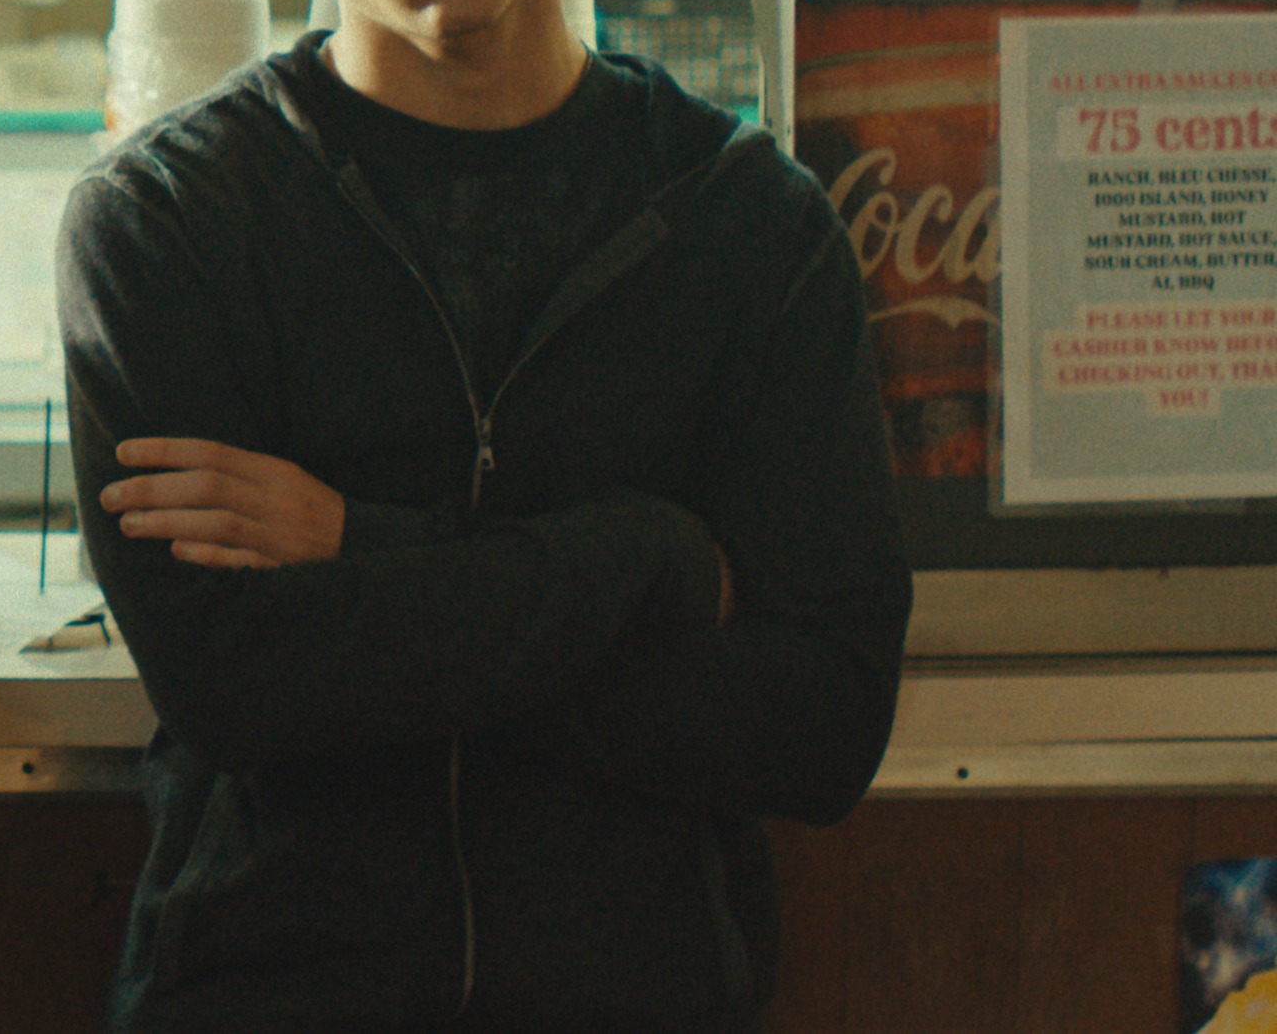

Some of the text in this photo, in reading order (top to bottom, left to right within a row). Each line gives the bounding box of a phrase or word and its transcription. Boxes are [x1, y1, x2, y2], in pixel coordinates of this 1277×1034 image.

[1078, 106, 1277, 153] 75 cents
[1088, 169, 1154, 186] RANCH,
[1094, 189, 1268, 207] 1000 ISLAND, HONEY
[1119, 210, 1246, 227] MUSTARD, HOT
[1086, 232, 1175, 249] MUSTARD,
[1178, 231, 1214, 247] HOT
[1084, 254, 1132, 271] SOUR
[1135, 253, 1203, 270] CREAM,
[1178, 274, 1216, 291] BBQ
[1086, 311, 1166, 329] PLEASE
[1173, 309, 1212, 327] LET
[1052, 338, 1147, 358] CASHIER
[1152, 337, 1218, 355] KNOW
[1057, 364, 1172, 385] CHECKING
[1231, 361, 1277, 380] THA
